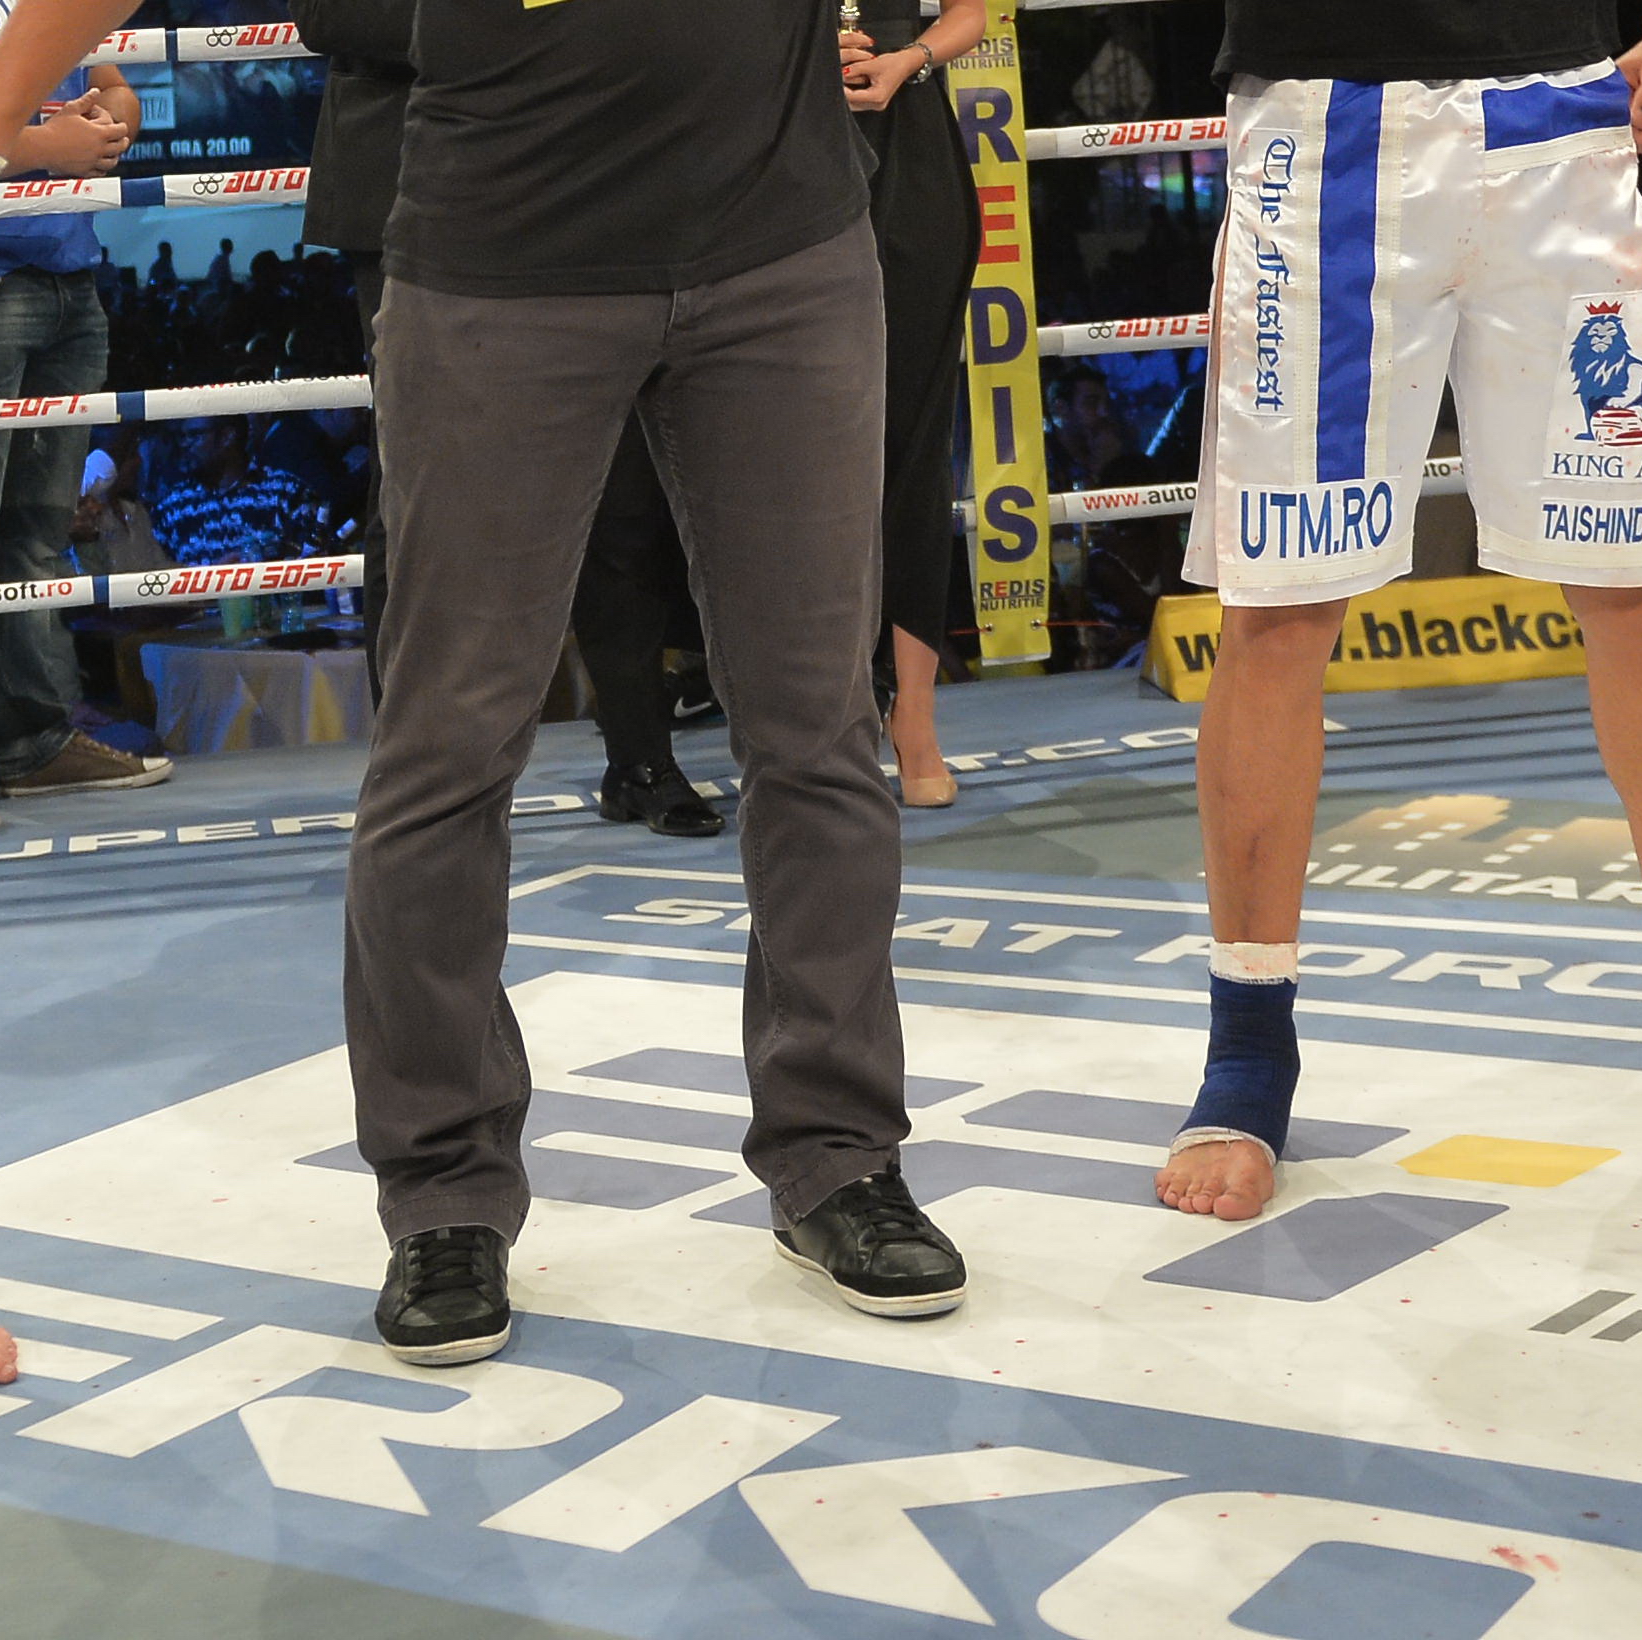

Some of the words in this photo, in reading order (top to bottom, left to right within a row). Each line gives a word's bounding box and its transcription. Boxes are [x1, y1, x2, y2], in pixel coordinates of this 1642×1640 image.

[1109, 122, 1182, 146] AUTO
[223, 170, 306, 193] AUTO
[1261, 135, 1296, 225] The
[1255, 233, 1289, 412] Fastest
[1552, 453, 1623, 478] KING
[1241, 481, 1392, 560] UTM.RO
[168, 567, 253, 596] AUTO
[259, 561, 341, 590] SOFT
[980, 579, 1045, 598] REDIS
[980, 596, 1044, 612] NUTRITIE
